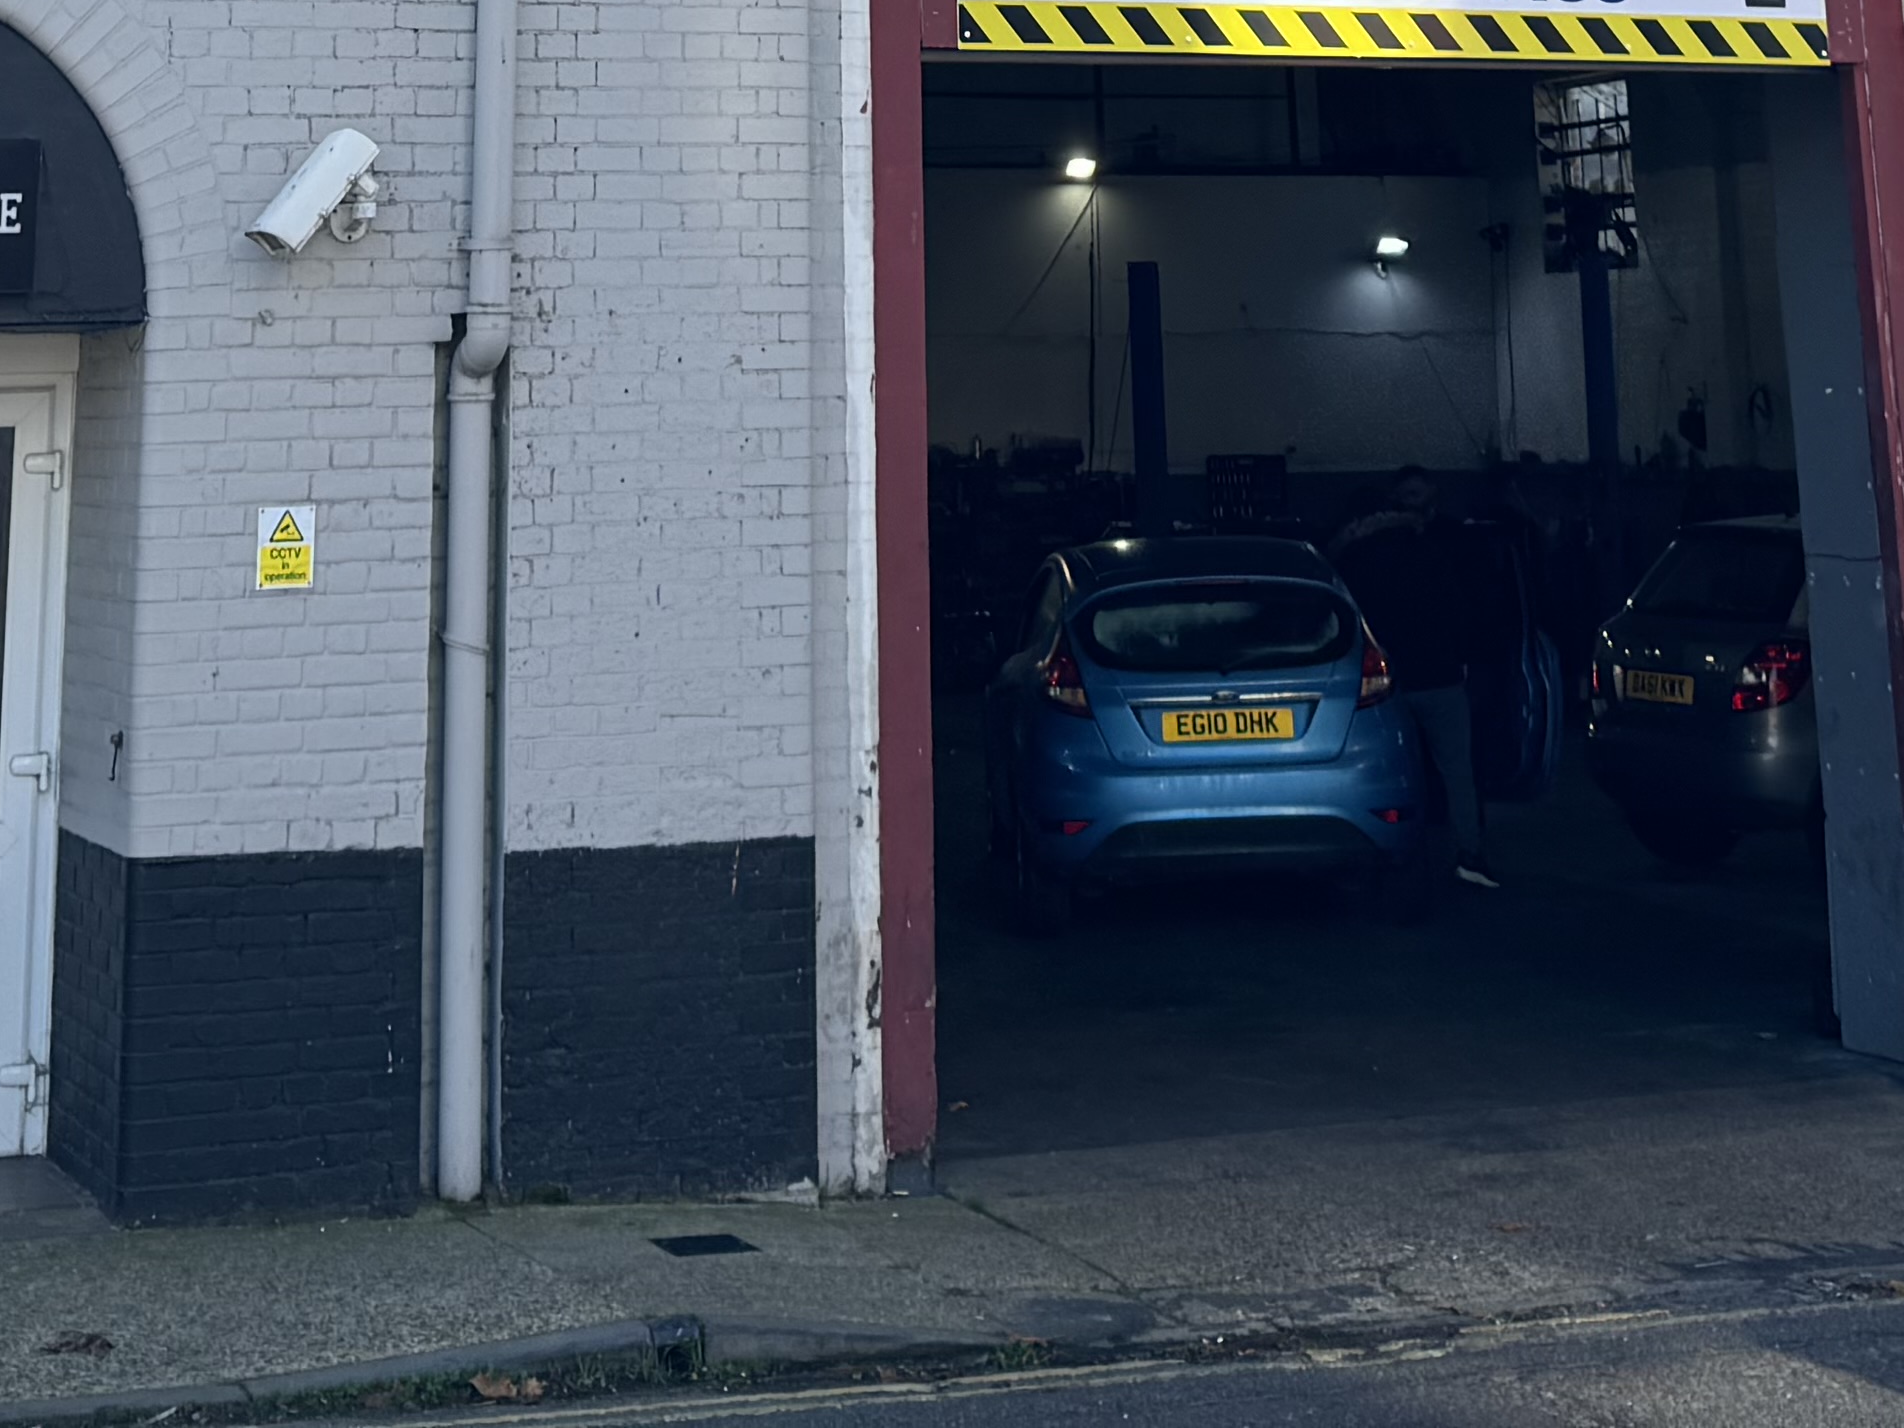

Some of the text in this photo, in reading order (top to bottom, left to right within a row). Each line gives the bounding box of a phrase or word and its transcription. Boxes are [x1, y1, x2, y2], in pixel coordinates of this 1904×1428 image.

[270, 547, 302, 560] CCTV
[281, 560, 290, 570] in
[264, 571, 307, 583] operation
[1176, 711, 1280, 736] EG10 DHK
